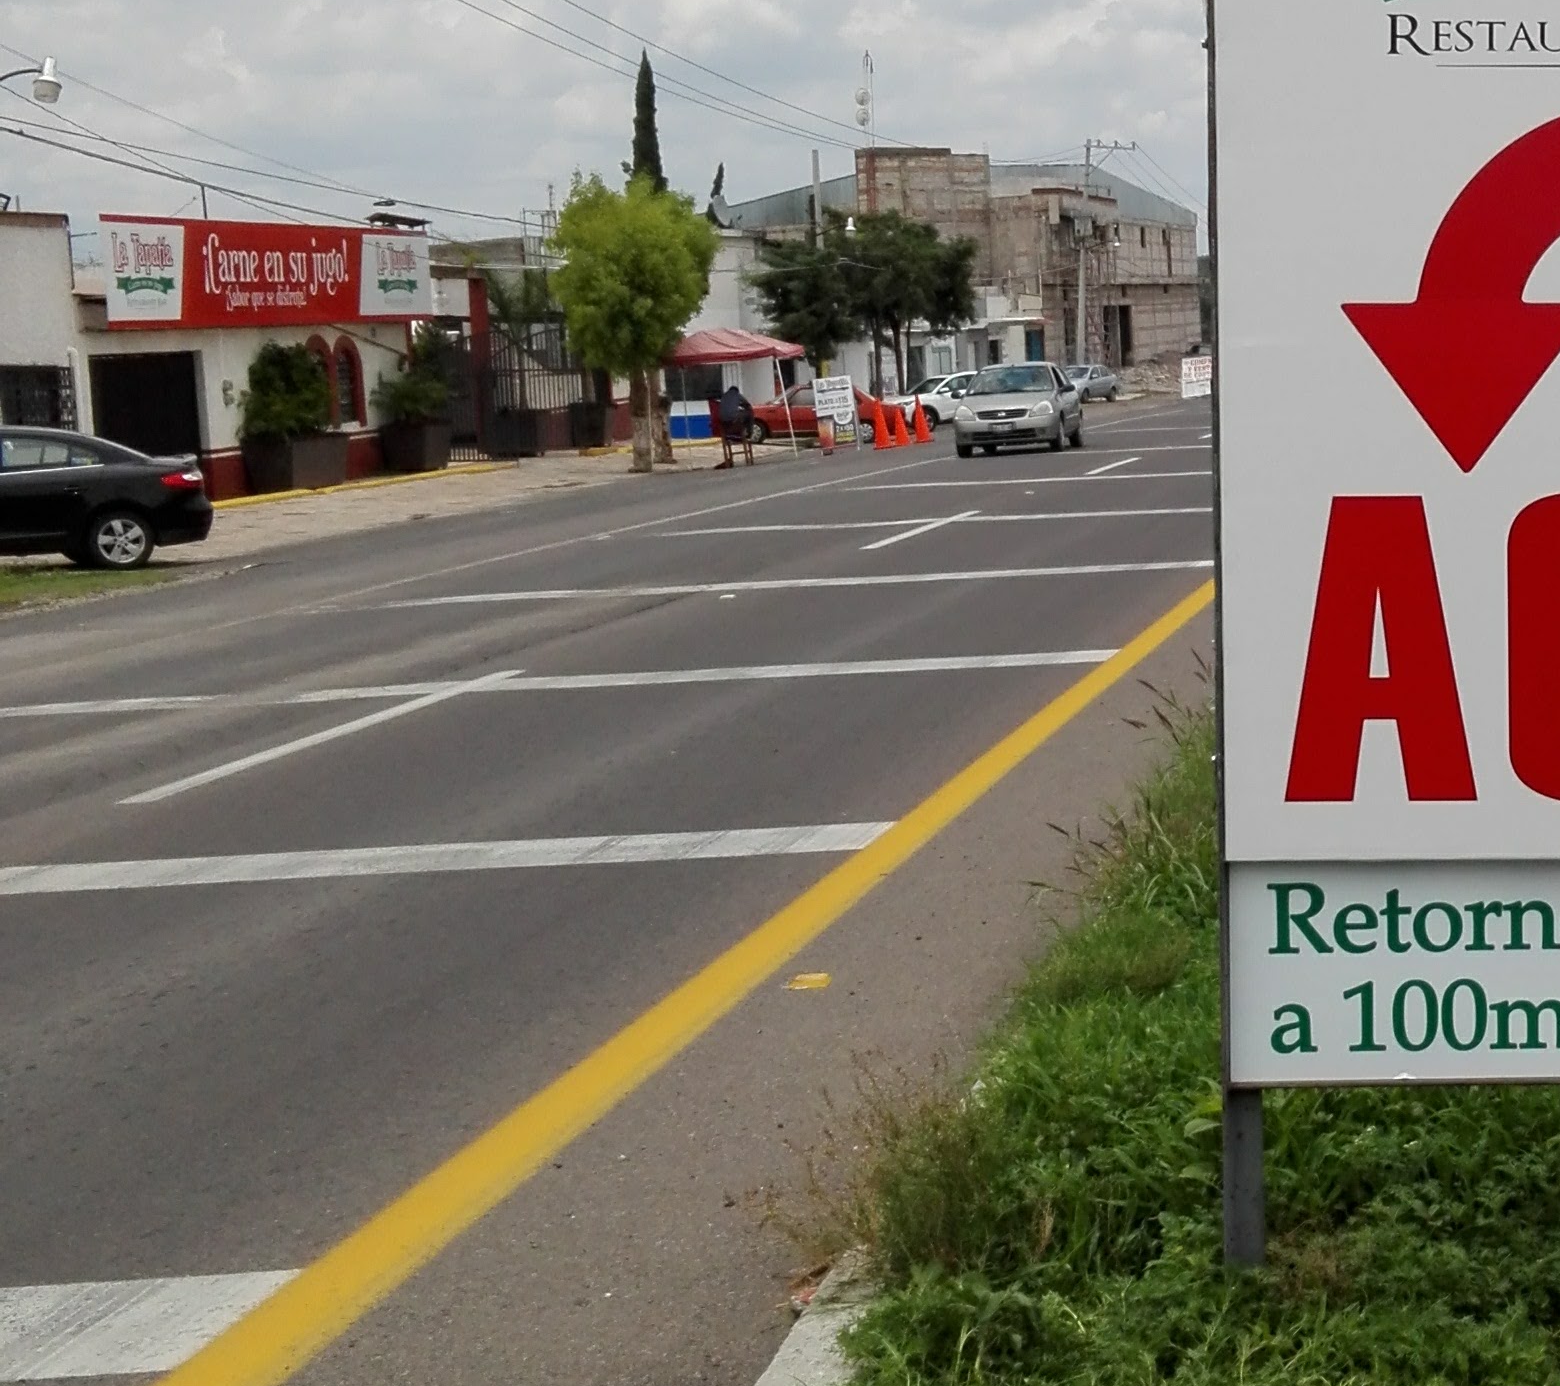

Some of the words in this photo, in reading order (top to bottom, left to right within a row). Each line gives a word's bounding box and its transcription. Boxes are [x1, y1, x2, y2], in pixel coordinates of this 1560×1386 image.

[111, 231, 129, 273] La
[264, 250, 285, 282] en
[289, 251, 307, 282] su
[310, 236, 349, 295] jugo!
[1270, 1003, 1317, 1055] a
